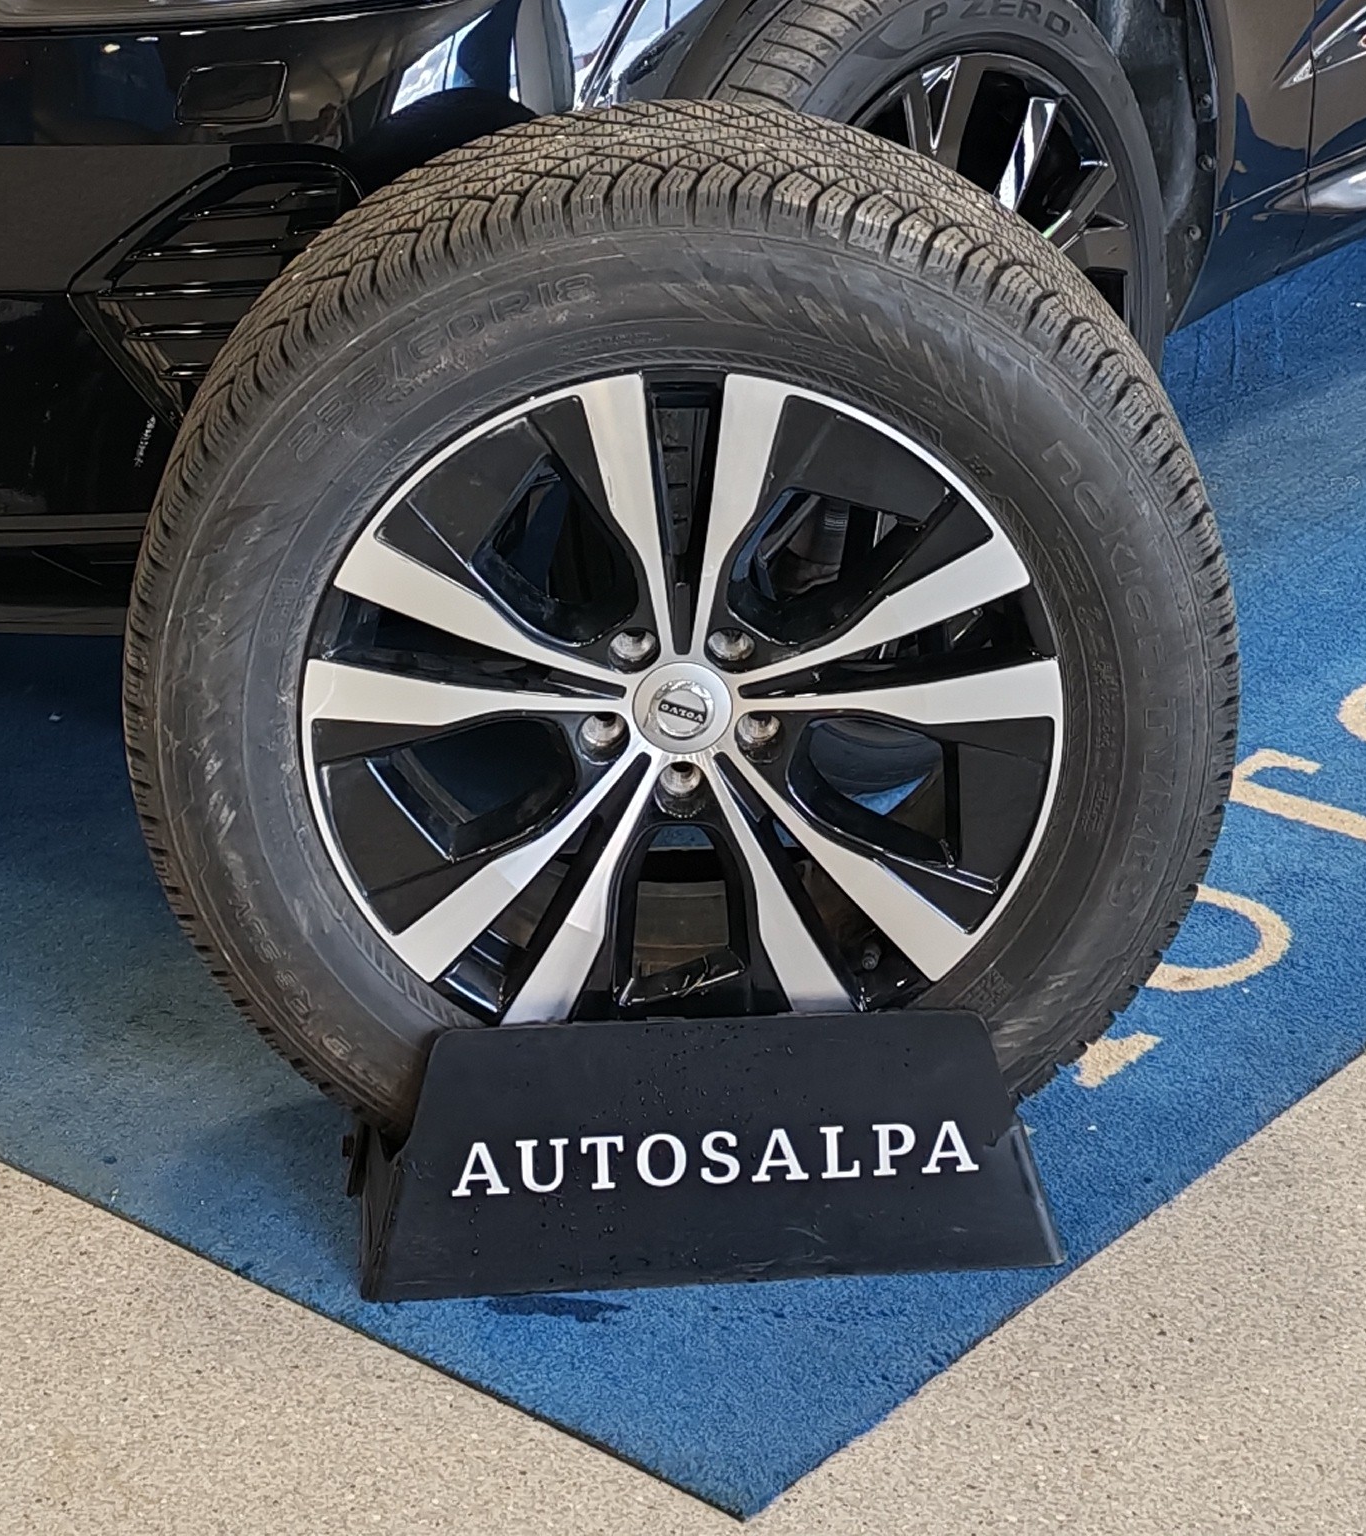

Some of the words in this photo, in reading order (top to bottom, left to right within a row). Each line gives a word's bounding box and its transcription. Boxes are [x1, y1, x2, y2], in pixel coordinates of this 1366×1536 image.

[921, 1, 949, 36] P
[660, 703, 705, 723] VOLVO
[450, 1119, 980, 1198] AUTOSALPA
